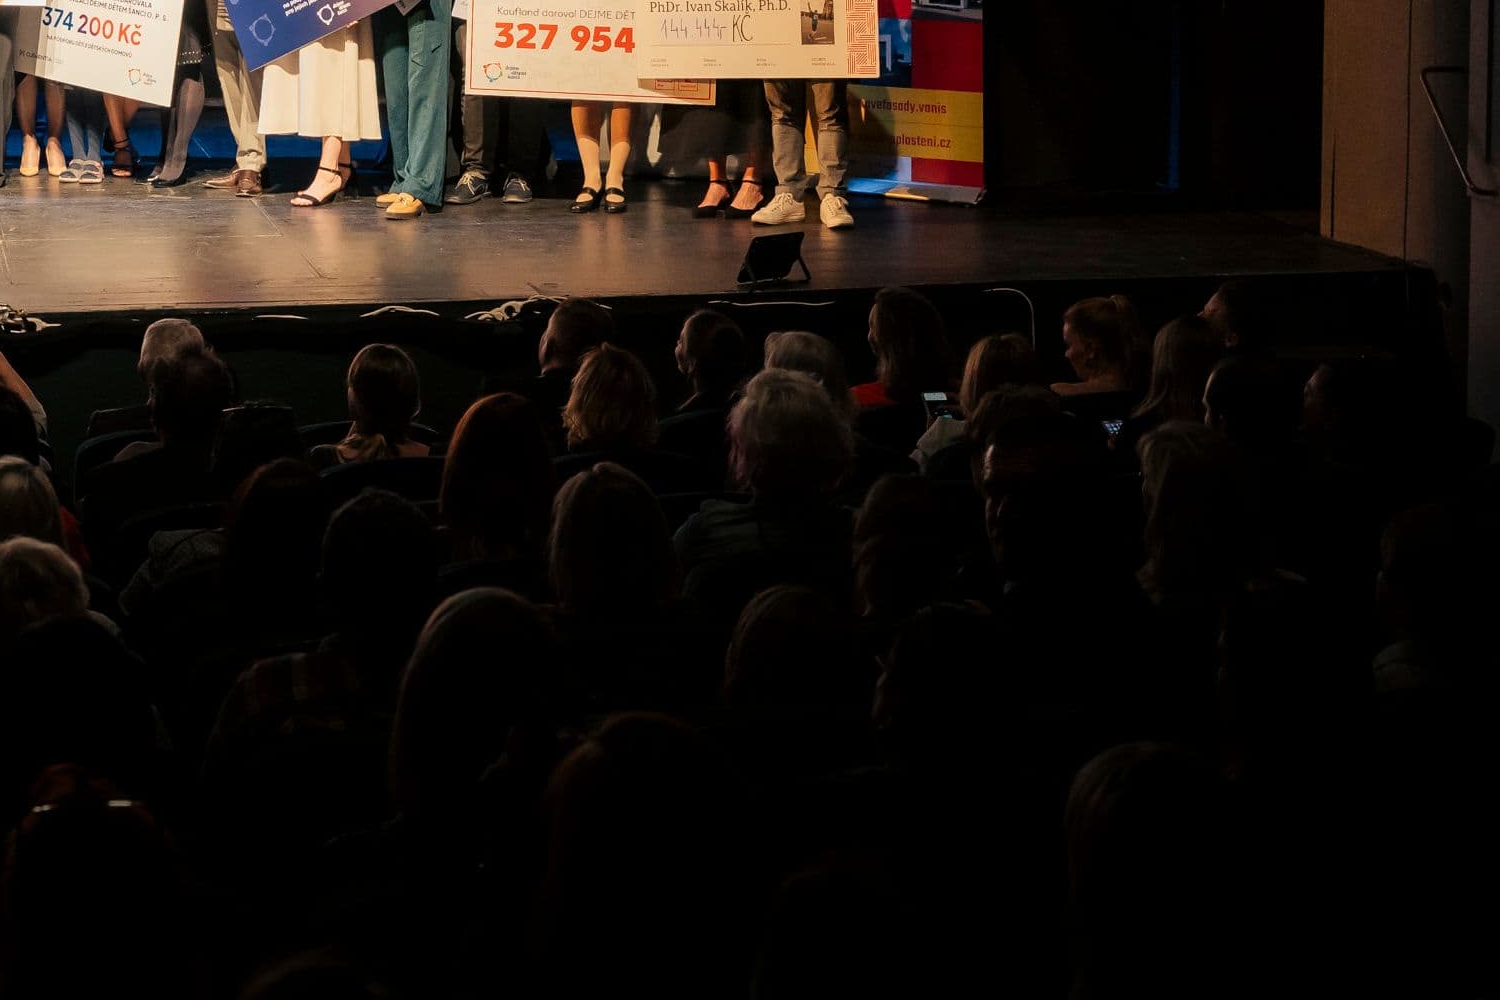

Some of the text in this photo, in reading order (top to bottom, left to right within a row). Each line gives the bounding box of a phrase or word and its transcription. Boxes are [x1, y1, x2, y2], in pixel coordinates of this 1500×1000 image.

[497, 6, 635, 20] Kaufland daroval DEJME DĚT
[650, 0, 791, 14] PhDr. Ivan Skalík, Ph.D.
[43, 6, 142, 46] 374 200 Kč
[494, 22, 636, 53] 327 954
